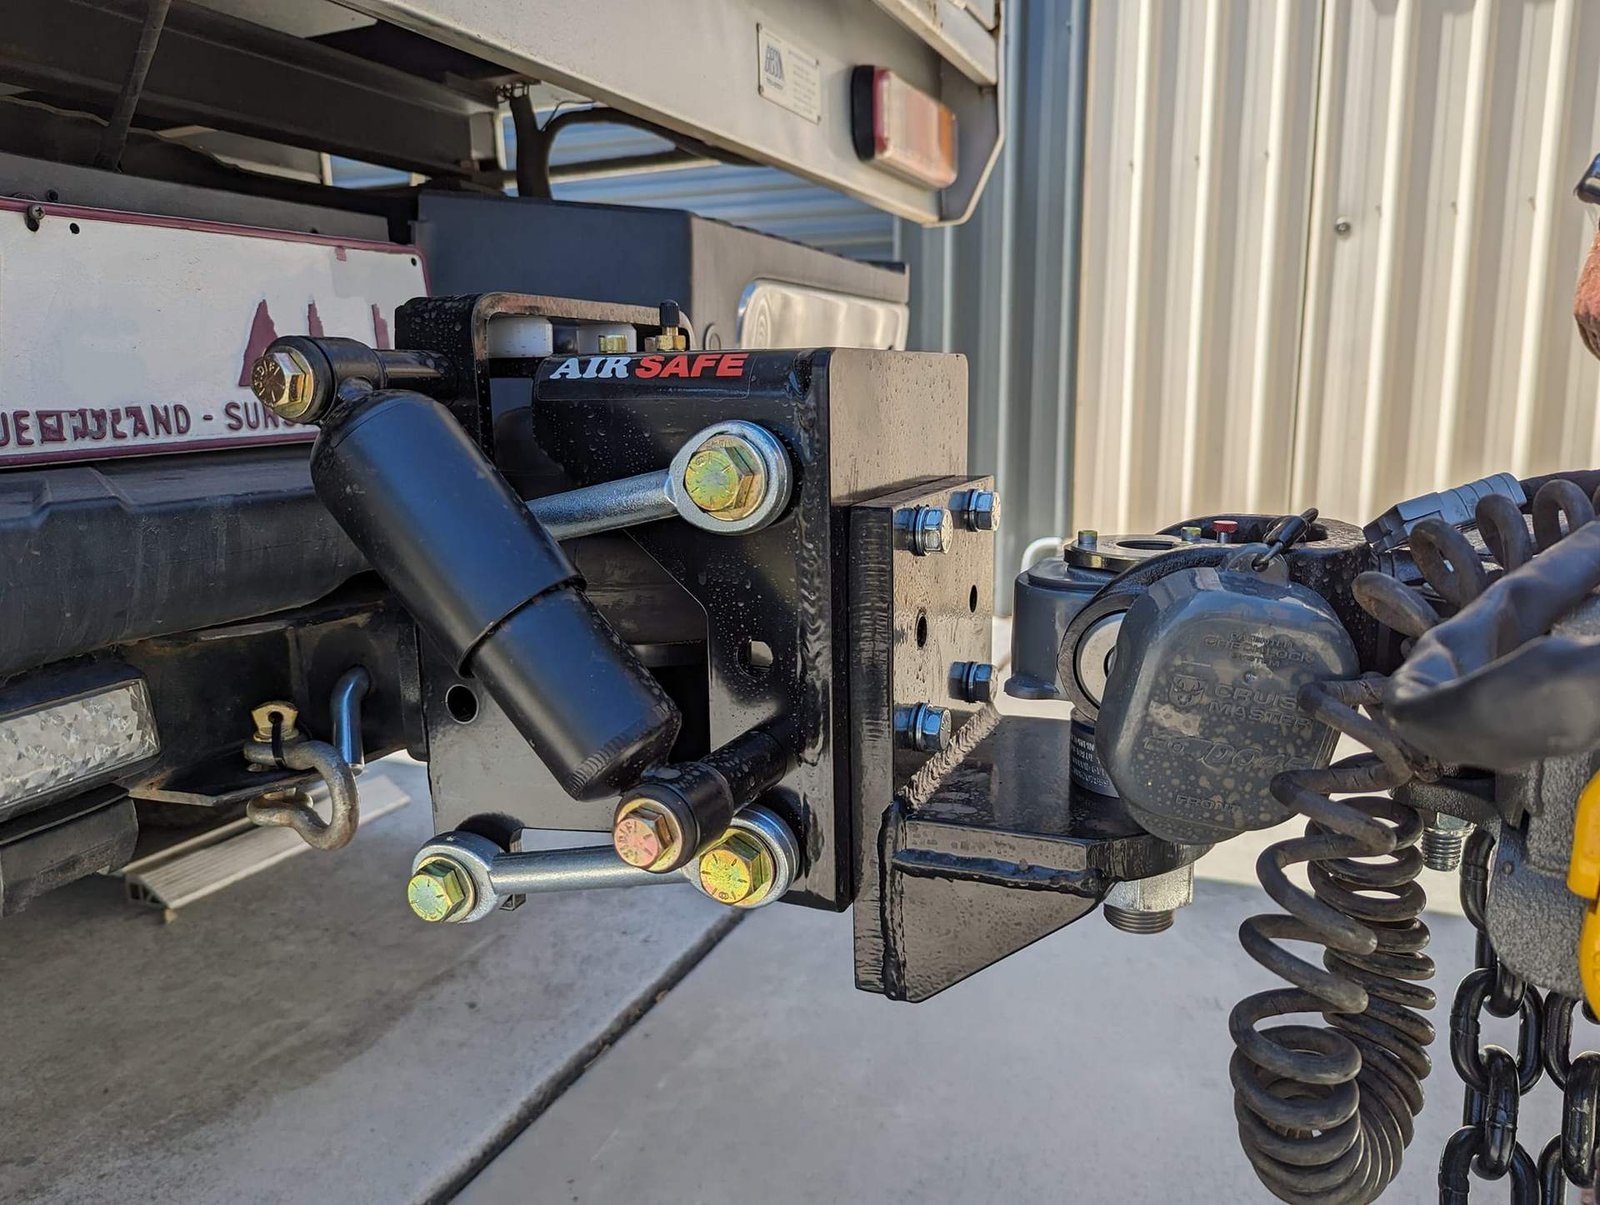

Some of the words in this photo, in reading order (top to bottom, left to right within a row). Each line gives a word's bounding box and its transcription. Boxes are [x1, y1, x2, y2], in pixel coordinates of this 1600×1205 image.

[550, 356, 632, 379] AIR
[635, 353, 750, 378] SAFE
[224, 401, 297, 430] SUN
[1214, 684, 1301, 711] CRUIS
[1208, 702, 1313, 729] MASTER
[1176, 795, 1241, 813] FRONT
